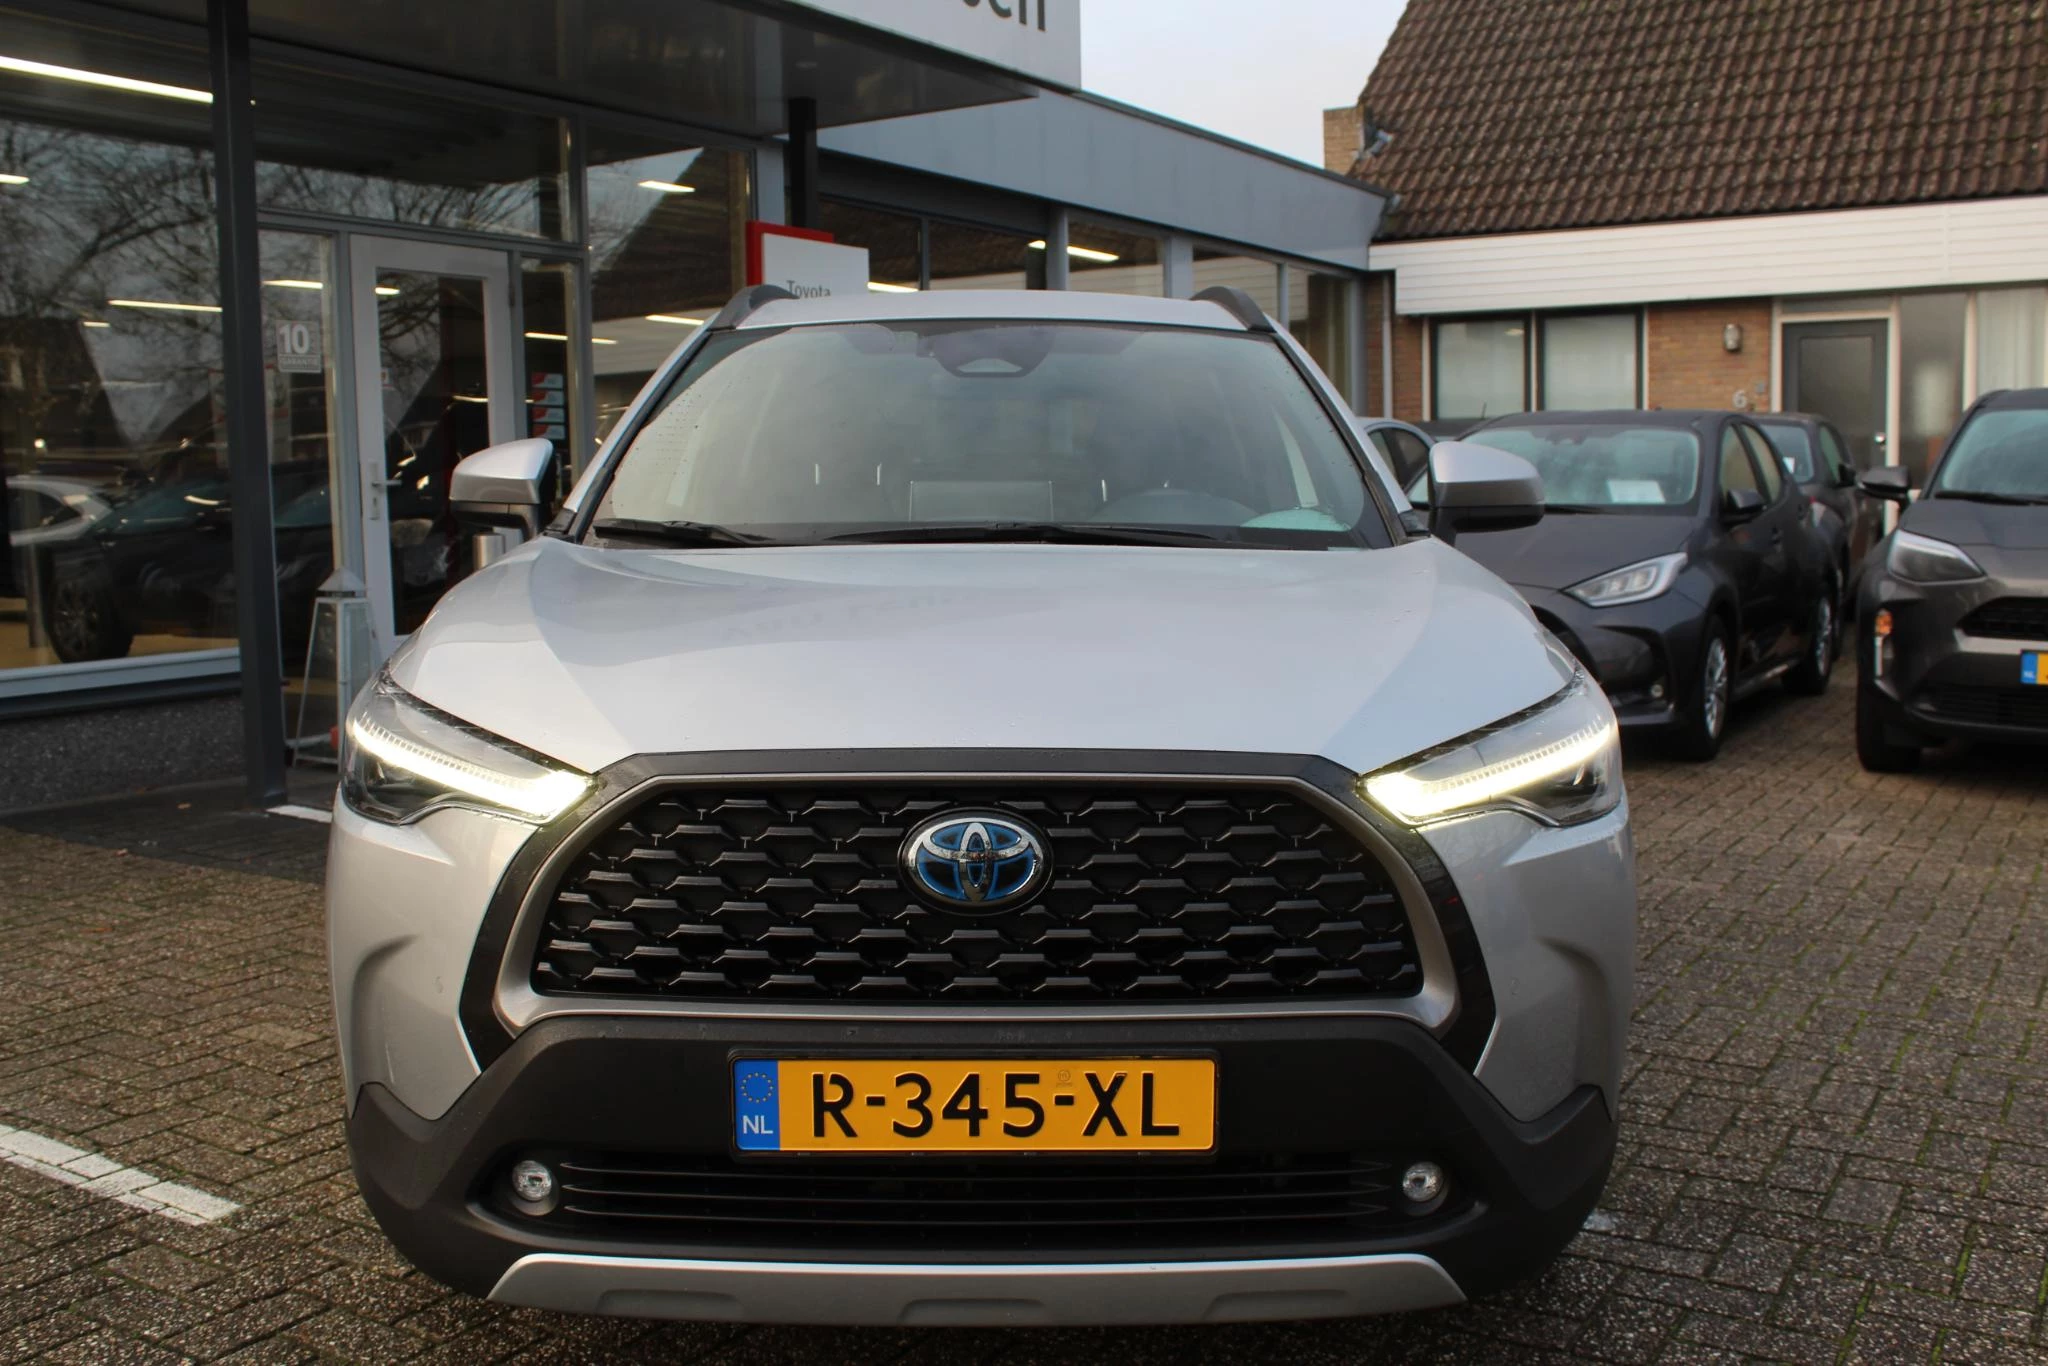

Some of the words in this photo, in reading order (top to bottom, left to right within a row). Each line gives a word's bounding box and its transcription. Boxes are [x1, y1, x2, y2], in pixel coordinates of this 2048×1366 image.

[786, 280, 831, 299] Toyota
[279, 324, 310, 354] 10
[812, 1072, 1180, 1138] R-345-XL
[742, 1114, 774, 1135] NL
